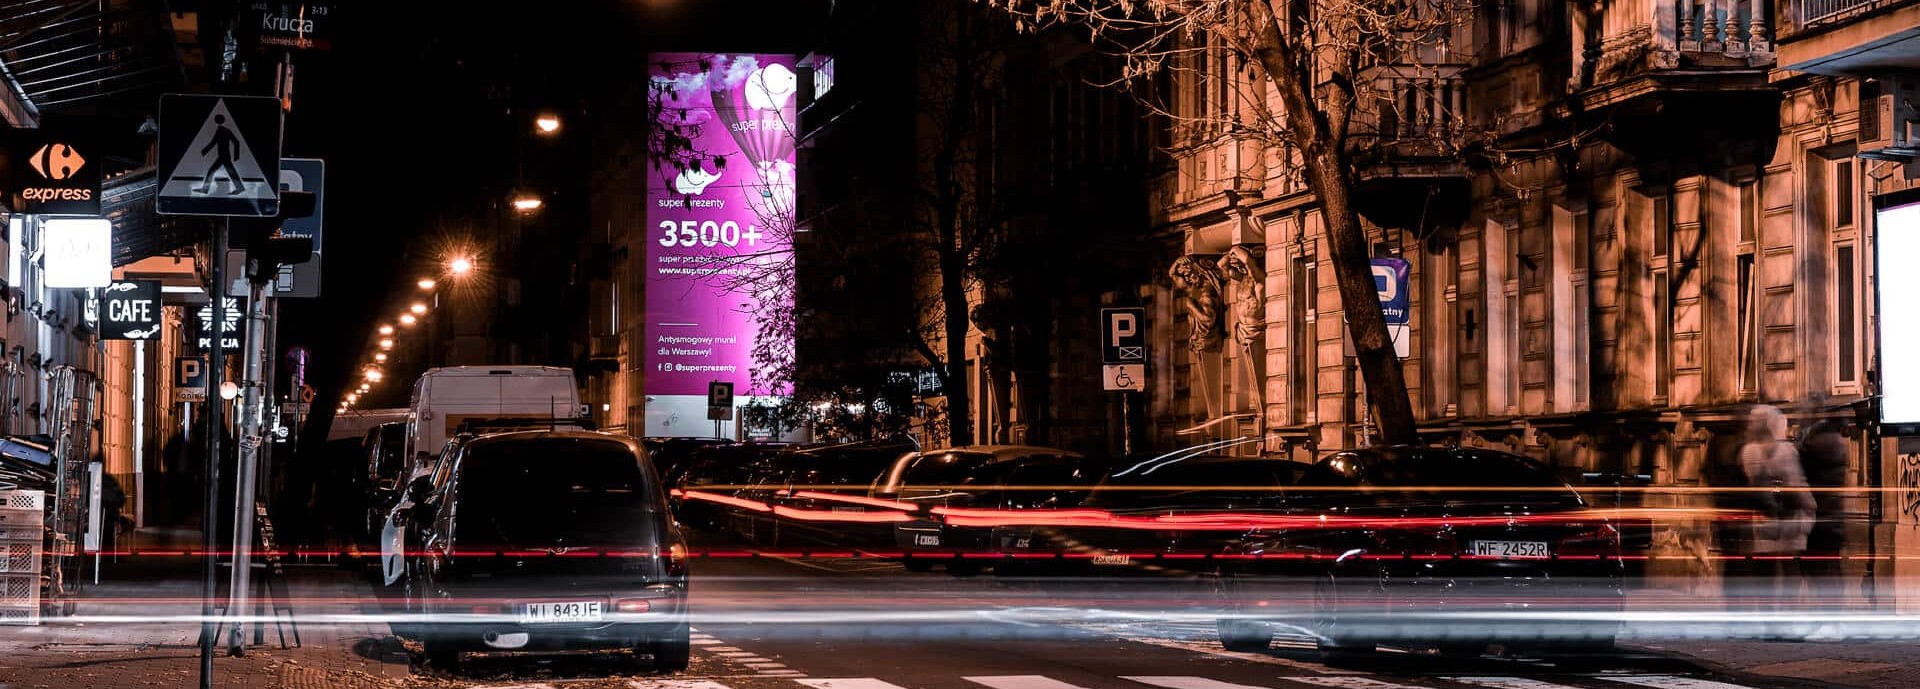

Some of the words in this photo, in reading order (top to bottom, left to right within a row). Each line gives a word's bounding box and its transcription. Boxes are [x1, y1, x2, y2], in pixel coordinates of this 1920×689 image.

[263, 12, 314, 33] Krucza
[731, 119, 760, 133] super
[22, 187, 92, 203] express
[658, 199, 684, 210] super
[685, 199, 725, 208] rezenty
[659, 220, 762, 248] 3500+
[659, 256, 681, 264] super
[658, 268, 751, 277] www.superprzenty.pl
[109, 299, 152, 322] CAFE
[1382, 307, 1403, 318] atny
[1111, 313, 1136, 347] P
[199, 338, 239, 348] POCJA
[658, 335, 713, 346] Antysmogowy
[714, 336, 737, 345] mural
[658, 348, 670, 356] dla
[182, 360, 199, 384] P
[675, 364, 737, 374] @superprezenty
[714, 385, 728, 404] P
[1477, 541, 1498, 556] WF
[1503, 542, 1546, 557] 2452R
[530, 604, 546, 618] WI
[553, 602, 599, 618] 843JE
